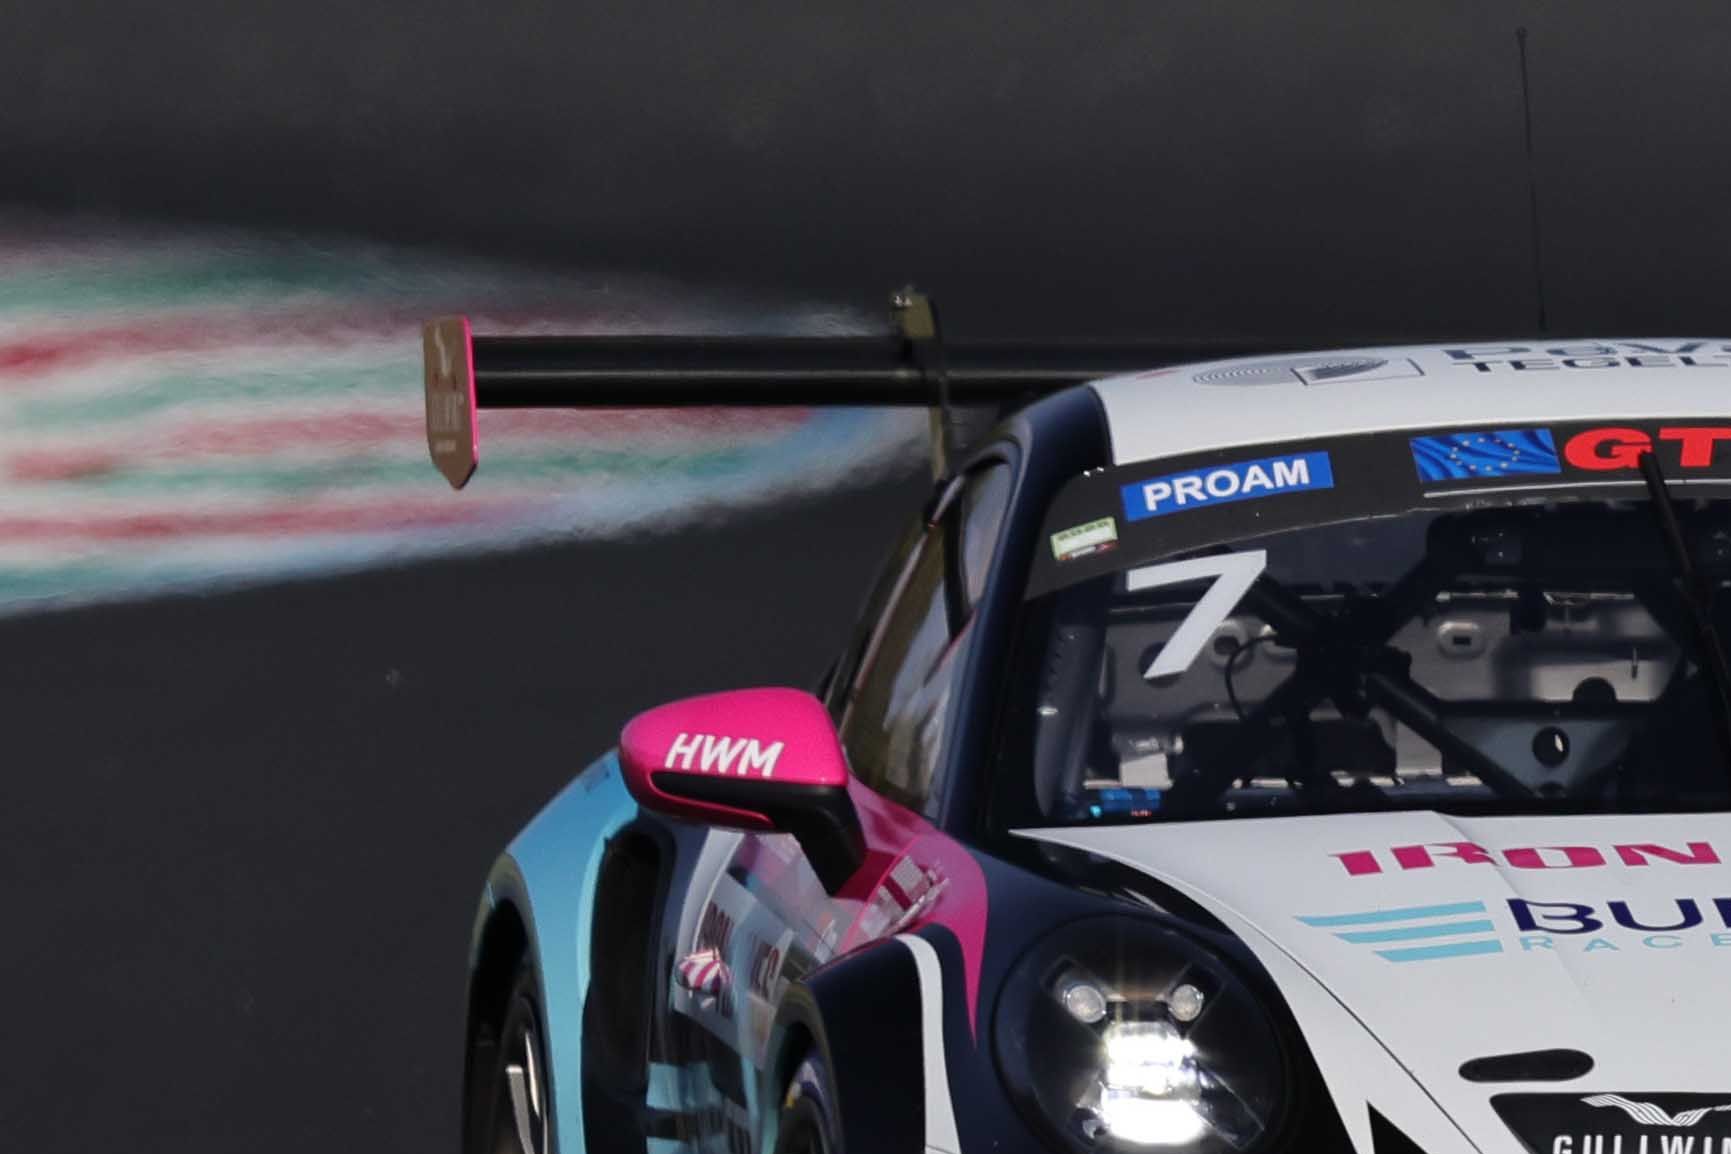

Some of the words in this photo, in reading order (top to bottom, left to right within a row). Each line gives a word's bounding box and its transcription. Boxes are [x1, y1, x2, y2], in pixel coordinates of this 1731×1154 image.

[1143, 458, 1311, 512] PROAM
[1126, 550, 1267, 680] 7
[664, 732, 784, 778] HWM
[1329, 840, 1721, 876] IRON
